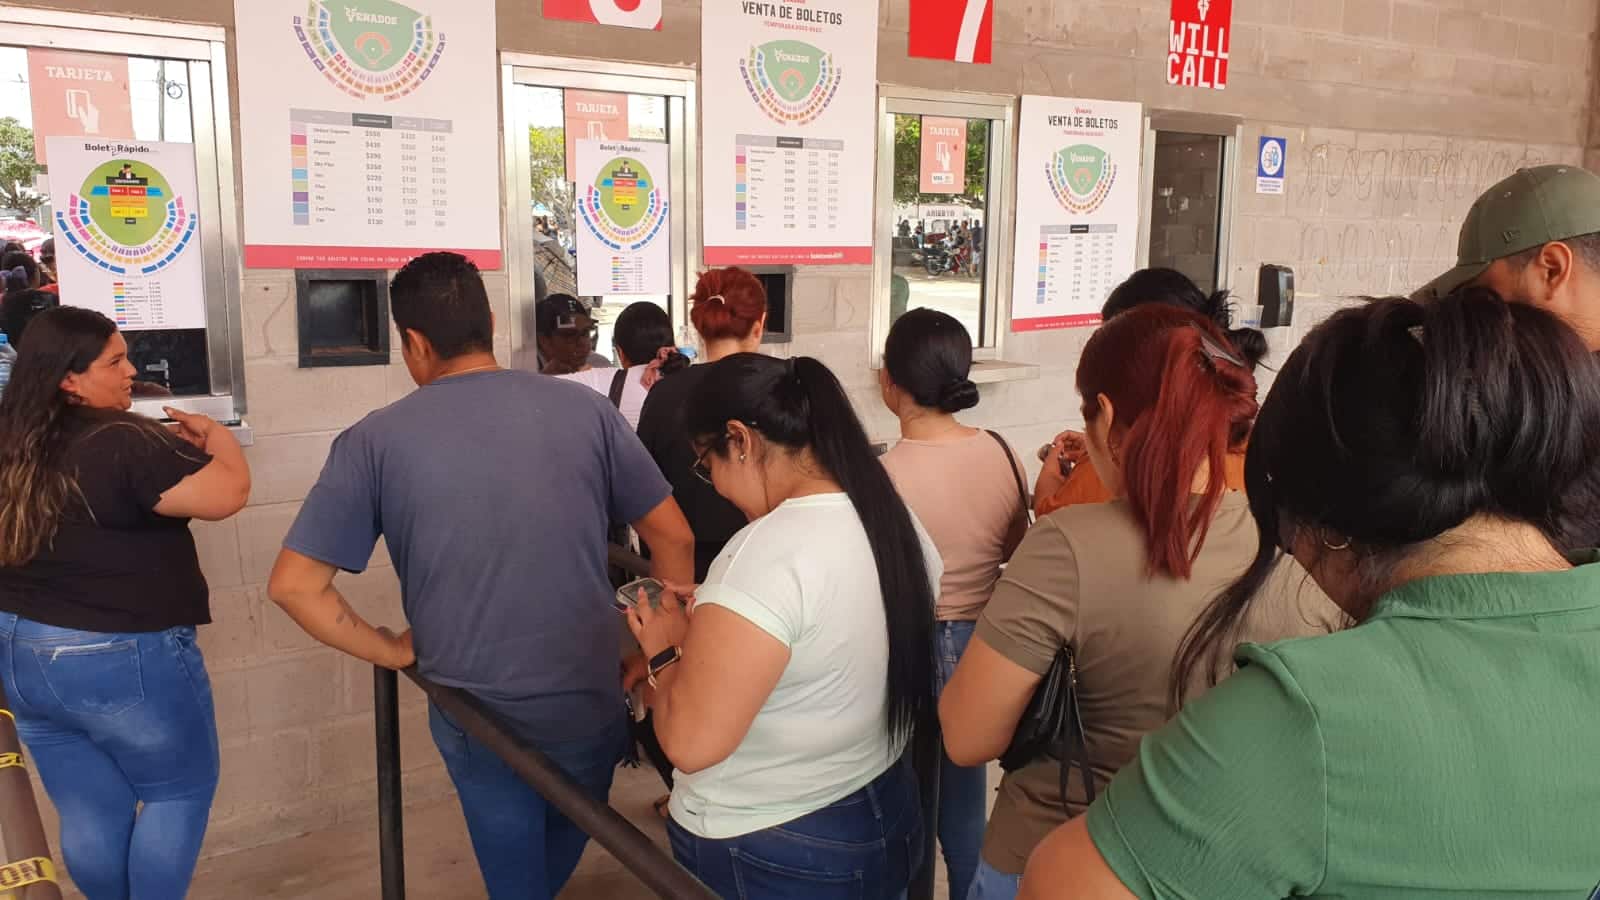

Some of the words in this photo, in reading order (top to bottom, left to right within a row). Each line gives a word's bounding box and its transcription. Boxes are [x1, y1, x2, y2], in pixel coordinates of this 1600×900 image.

[742, 0, 776, 17] VENTA
[779, 5, 793, 19] DE
[796, 7, 842, 25] BOLETOS
[1169, 20, 1229, 59] WILL
[45, 66, 113, 82] TARJETA
[1167, 53, 1226, 90] CALL
[576, 102, 620, 115] TARJETA
[1048, 115, 1072, 127] VENTA
[1074, 116, 1083, 128] DE
[1085, 117, 1119, 129] BOLETOS
[929, 126, 960, 138] TARJETA
